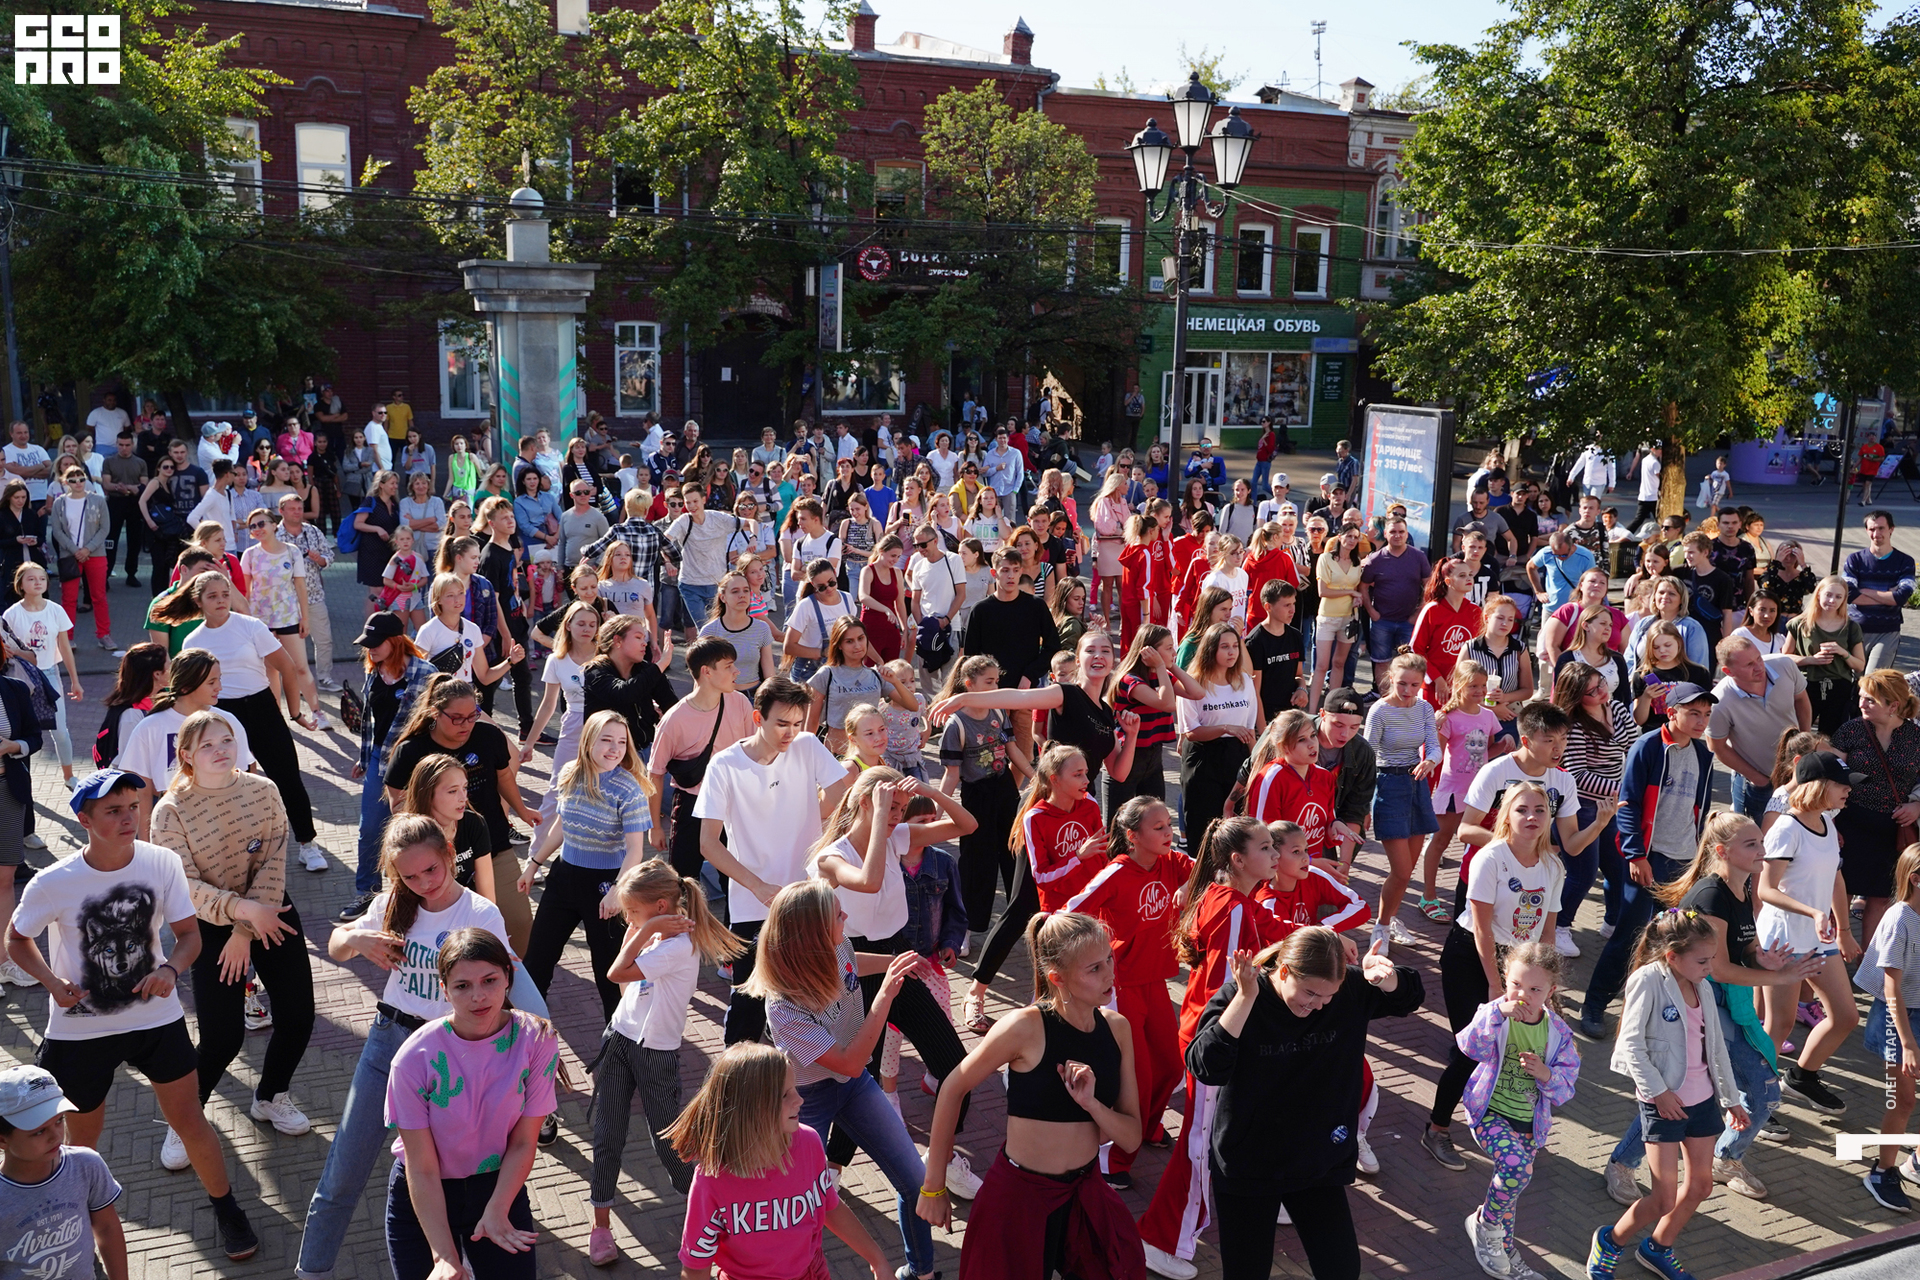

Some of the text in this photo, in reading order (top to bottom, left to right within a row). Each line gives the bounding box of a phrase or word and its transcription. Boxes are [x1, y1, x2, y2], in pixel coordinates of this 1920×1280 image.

[1186, 317, 1321, 335] НЕМЕЦКАЯ ОБУВЬ
[1374, 444, 1422, 461] ТАРИФИЩЕ
[1373, 459, 1383, 468] от
[1384, 458, 1397, 470] 315
